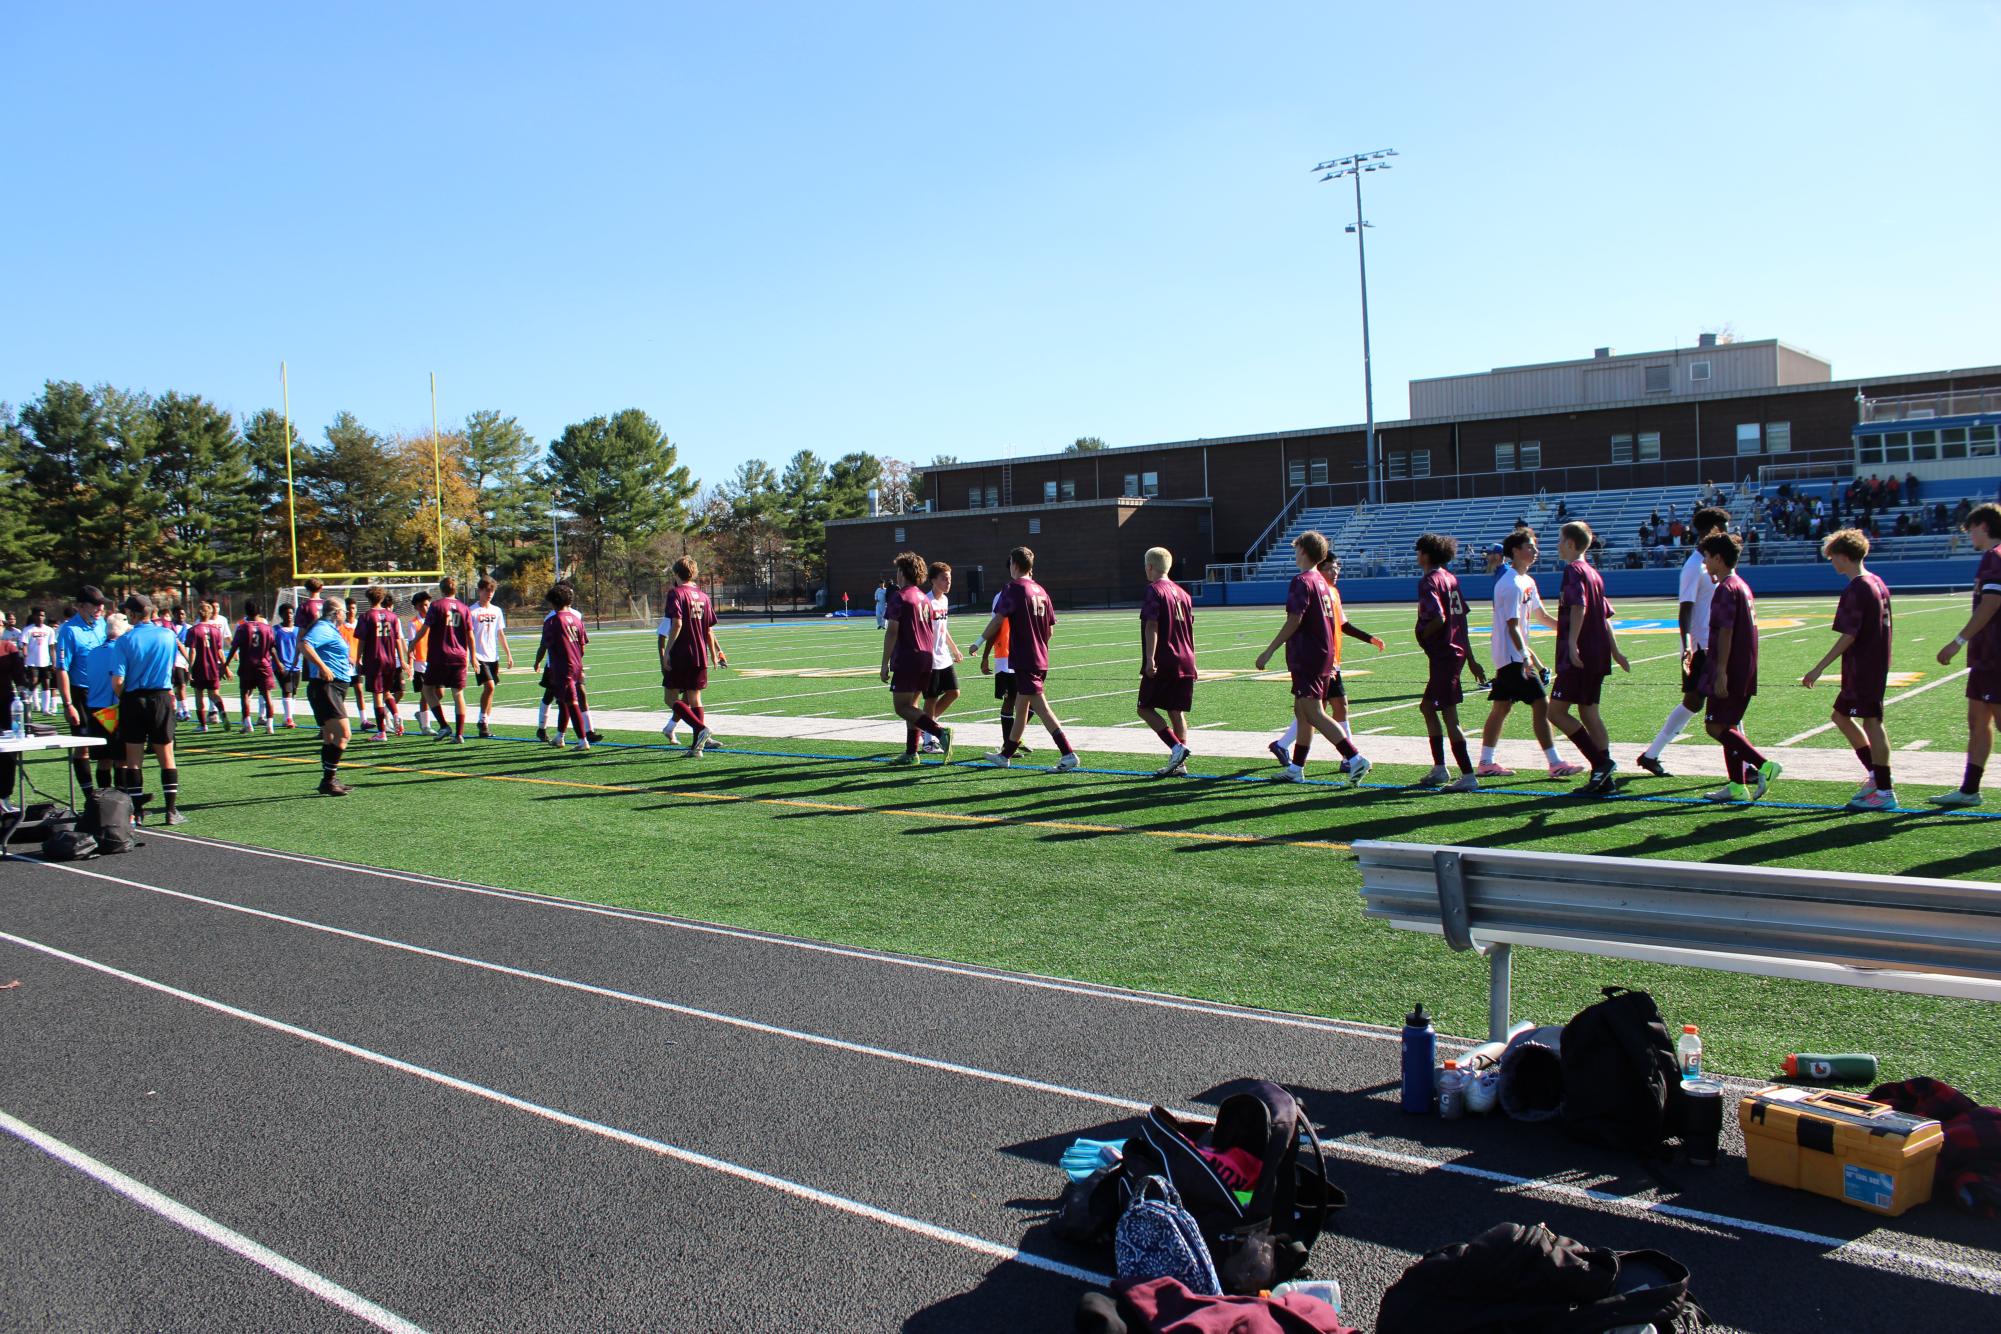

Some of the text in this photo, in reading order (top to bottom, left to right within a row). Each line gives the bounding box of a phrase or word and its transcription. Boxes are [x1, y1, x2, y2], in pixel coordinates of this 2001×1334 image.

[918, 602, 930, 621] 14
[1031, 595, 1046, 617] 15
[446, 611, 461, 628] 20
[478, 614, 496, 623] CSP
[376, 622, 391, 637] 22
[252, 634, 259, 648] 3
[1688, 1056, 1698, 1066] G
[1809, 1061, 1832, 1079] G
[1441, 1094, 1449, 1105] G
